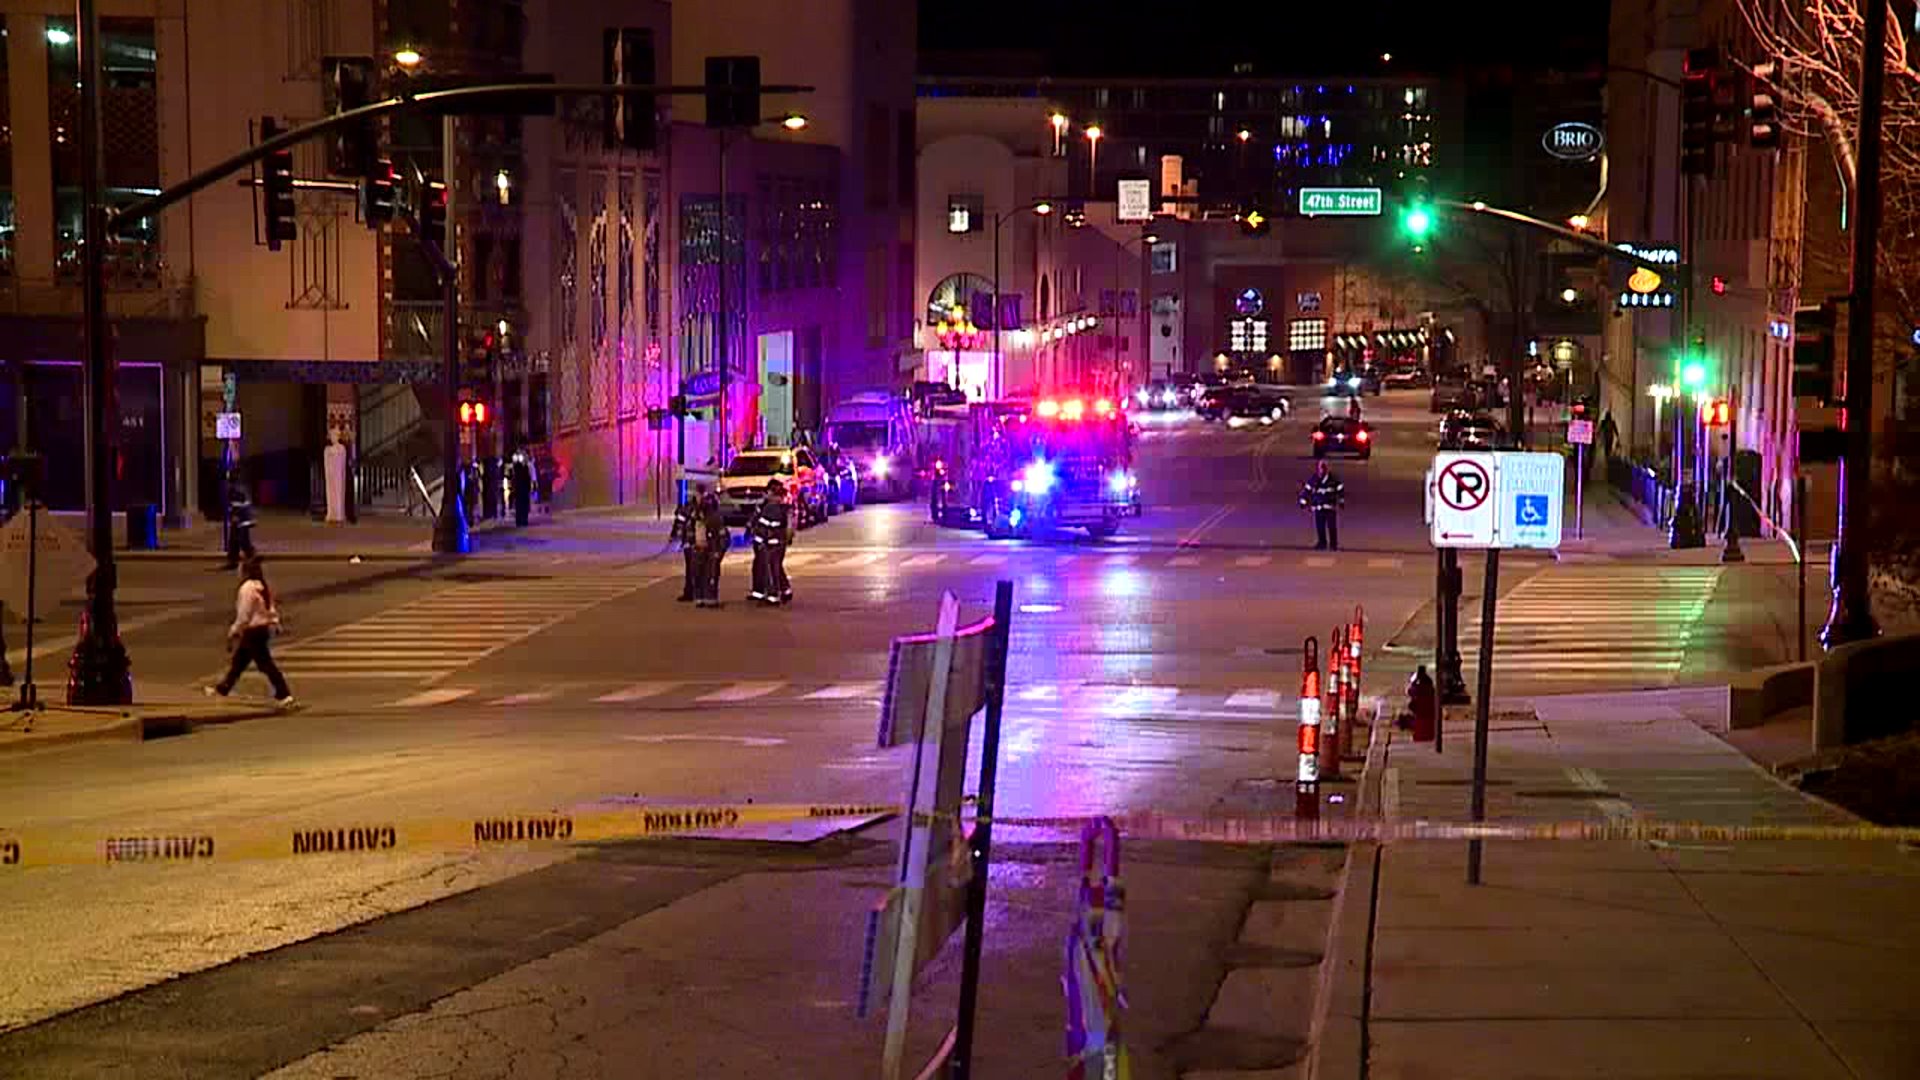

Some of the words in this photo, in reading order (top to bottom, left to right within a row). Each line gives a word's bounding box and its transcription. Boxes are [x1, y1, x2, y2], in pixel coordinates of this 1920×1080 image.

[1554, 130, 1594, 147] BRIO
[1306, 194, 1334, 209] 47th
[1338, 194, 1375, 209] Street
[473, 816, 574, 845] CAUTION
[644, 808, 739, 833] CAUTION
[105, 836, 215, 865] CAUTION
[292, 826, 397, 855] CAUTION
